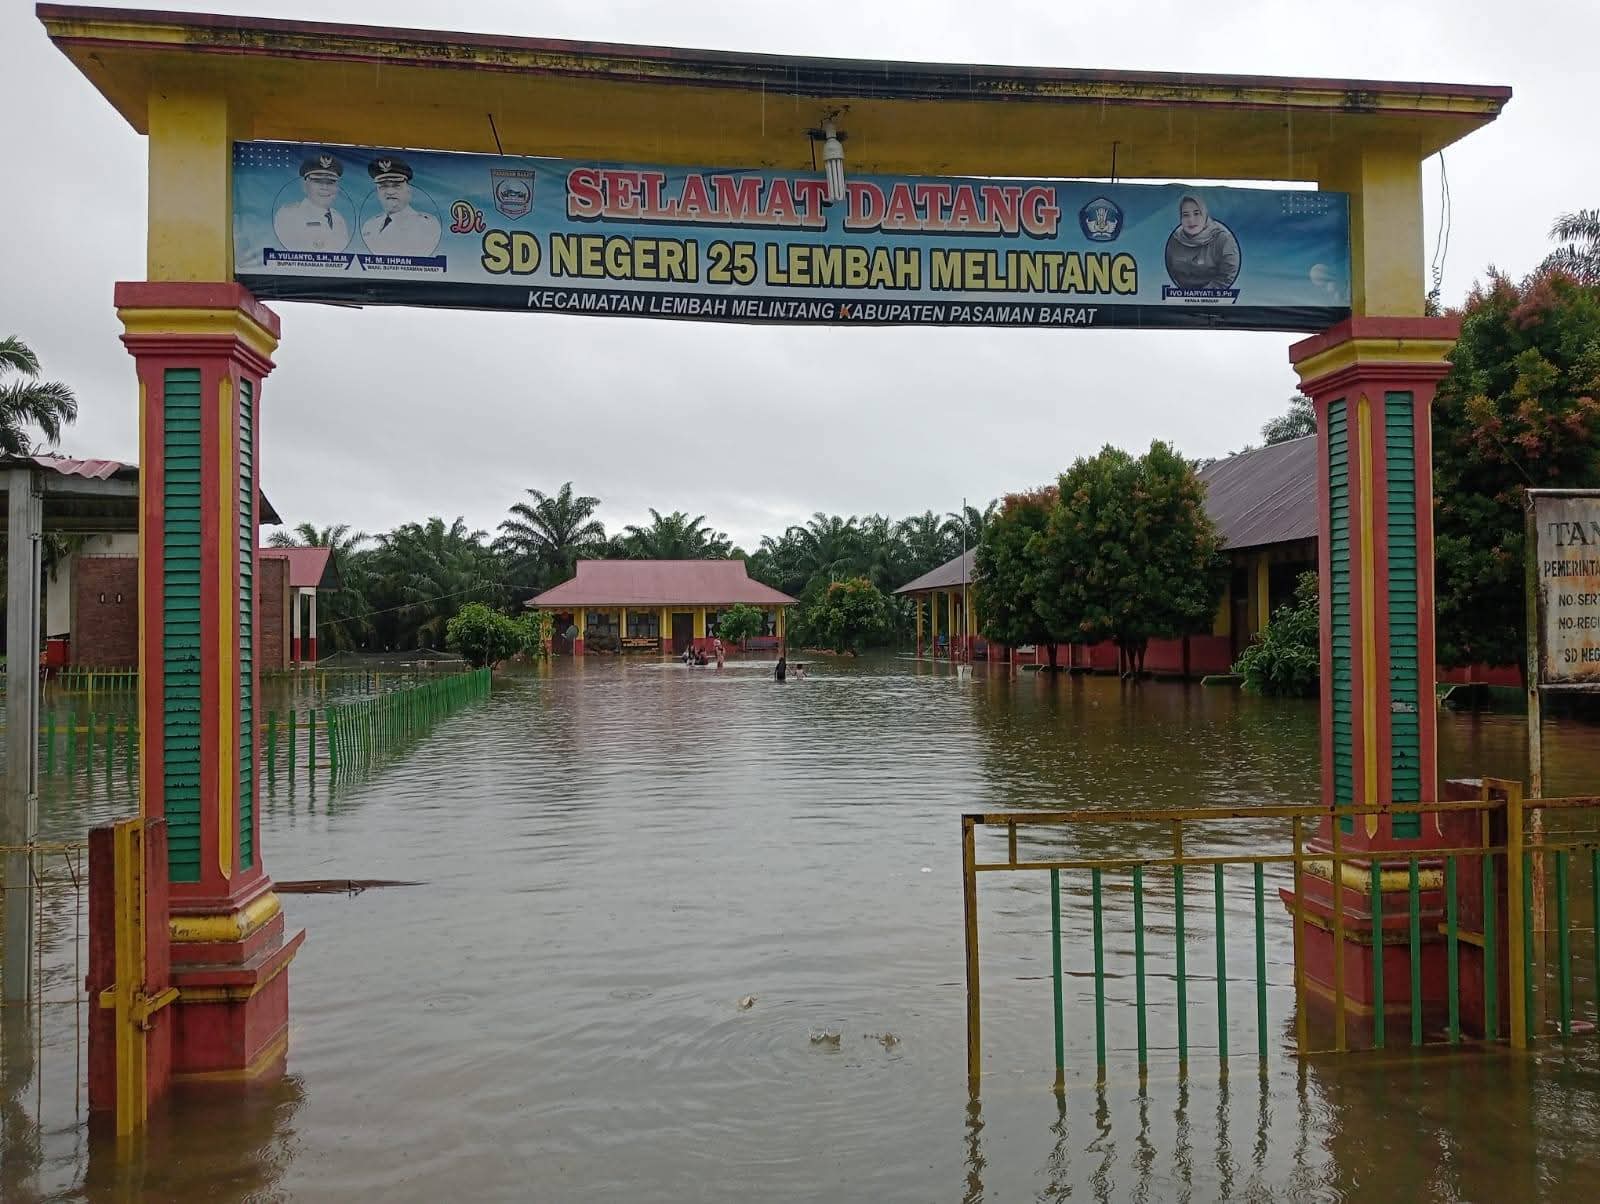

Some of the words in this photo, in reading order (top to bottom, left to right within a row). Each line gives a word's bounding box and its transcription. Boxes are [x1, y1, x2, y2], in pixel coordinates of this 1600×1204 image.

[450, 200, 487, 234] Di
[566, 167, 829, 230] SELAMAT
[844, 181, 1060, 238] DATANG
[482, 229, 541, 275] SD
[550, 233, 699, 283] NEGERI
[706, 240, 758, 285] 25
[765, 242, 921, 290] LEMBAH
[930, 249, 1138, 295] MELINTANG
[527, 290, 645, 312] KECAMATAN
[650, 296, 727, 316] LEMBAH
[731, 300, 834, 320] MELINTANG
[839, 303, 945, 322] KABUPATEN
[949, 305, 1038, 323] PASAMAN
[1039, 307, 1098, 325] BARAT
[1564, 648, 1578, 663] SD
